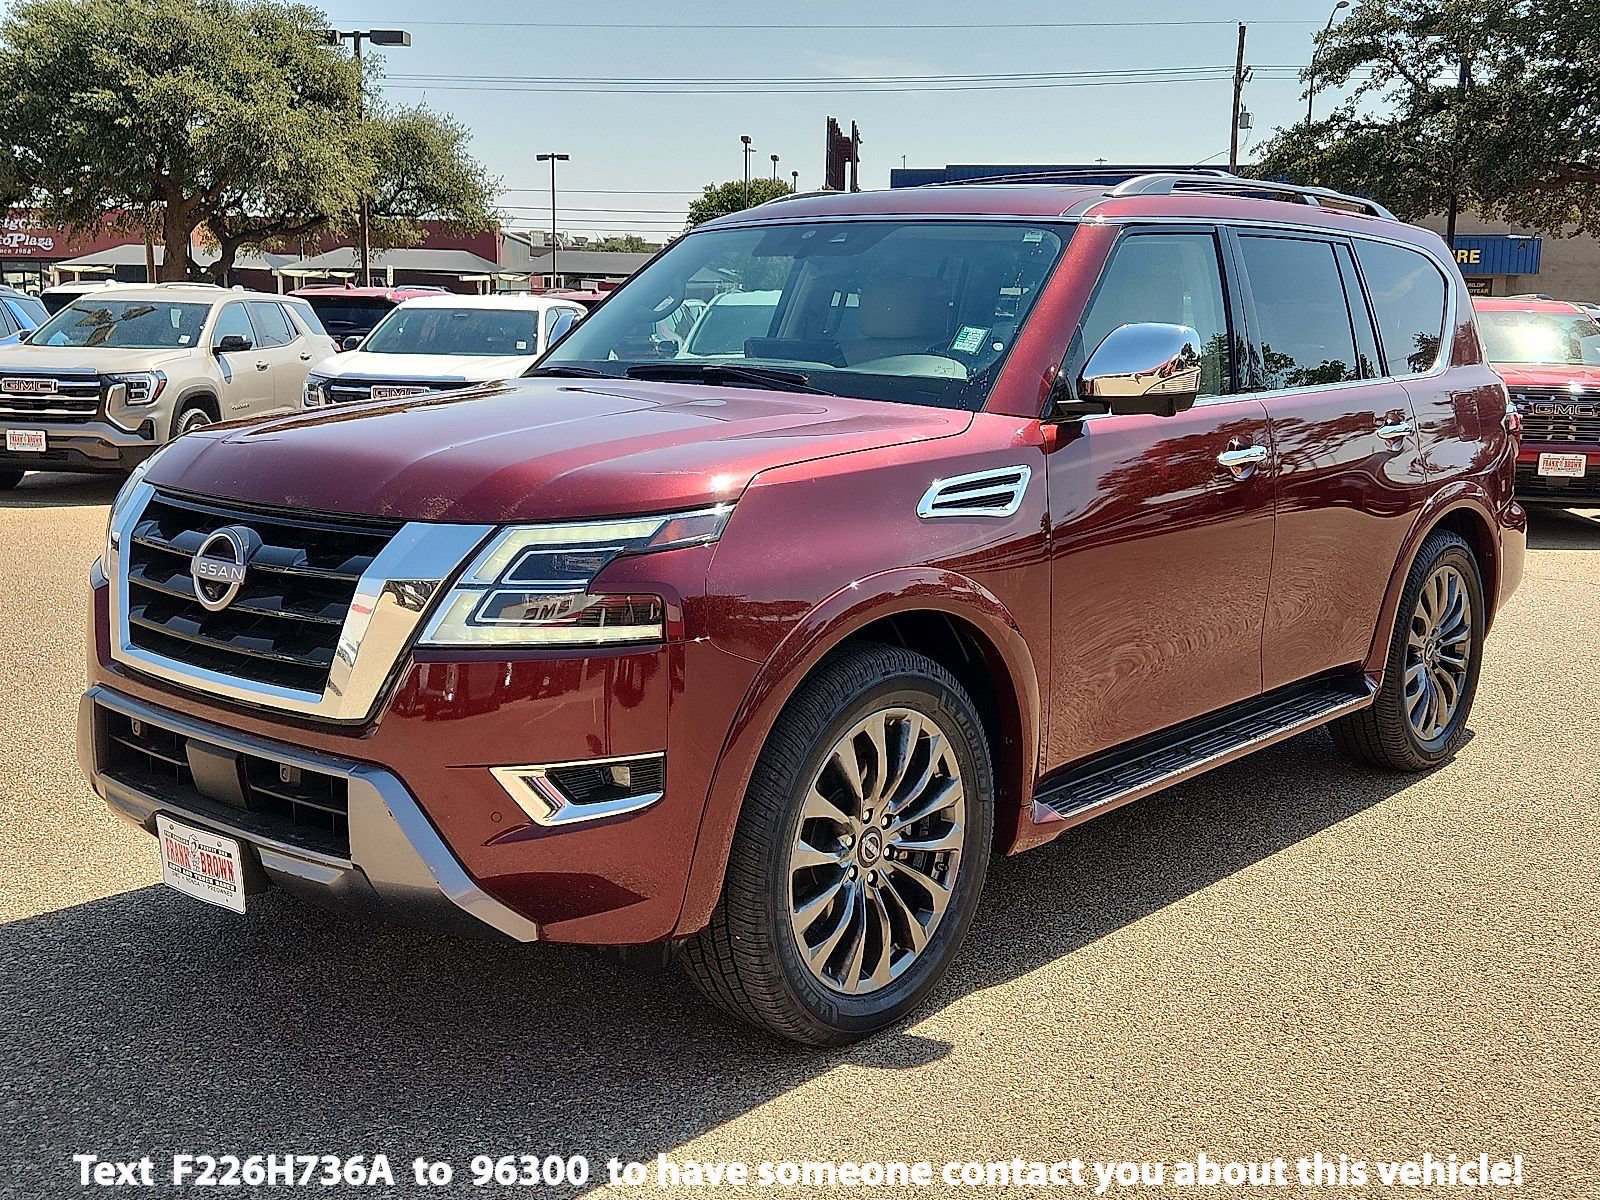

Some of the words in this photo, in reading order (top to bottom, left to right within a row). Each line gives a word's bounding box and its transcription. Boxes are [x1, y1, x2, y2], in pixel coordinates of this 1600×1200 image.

[3, 379, 53, 391] GMC
[1535, 403, 1594, 416] GMC
[165, 837, 191, 869] FRANK
[200, 851, 236, 884] BROWN
